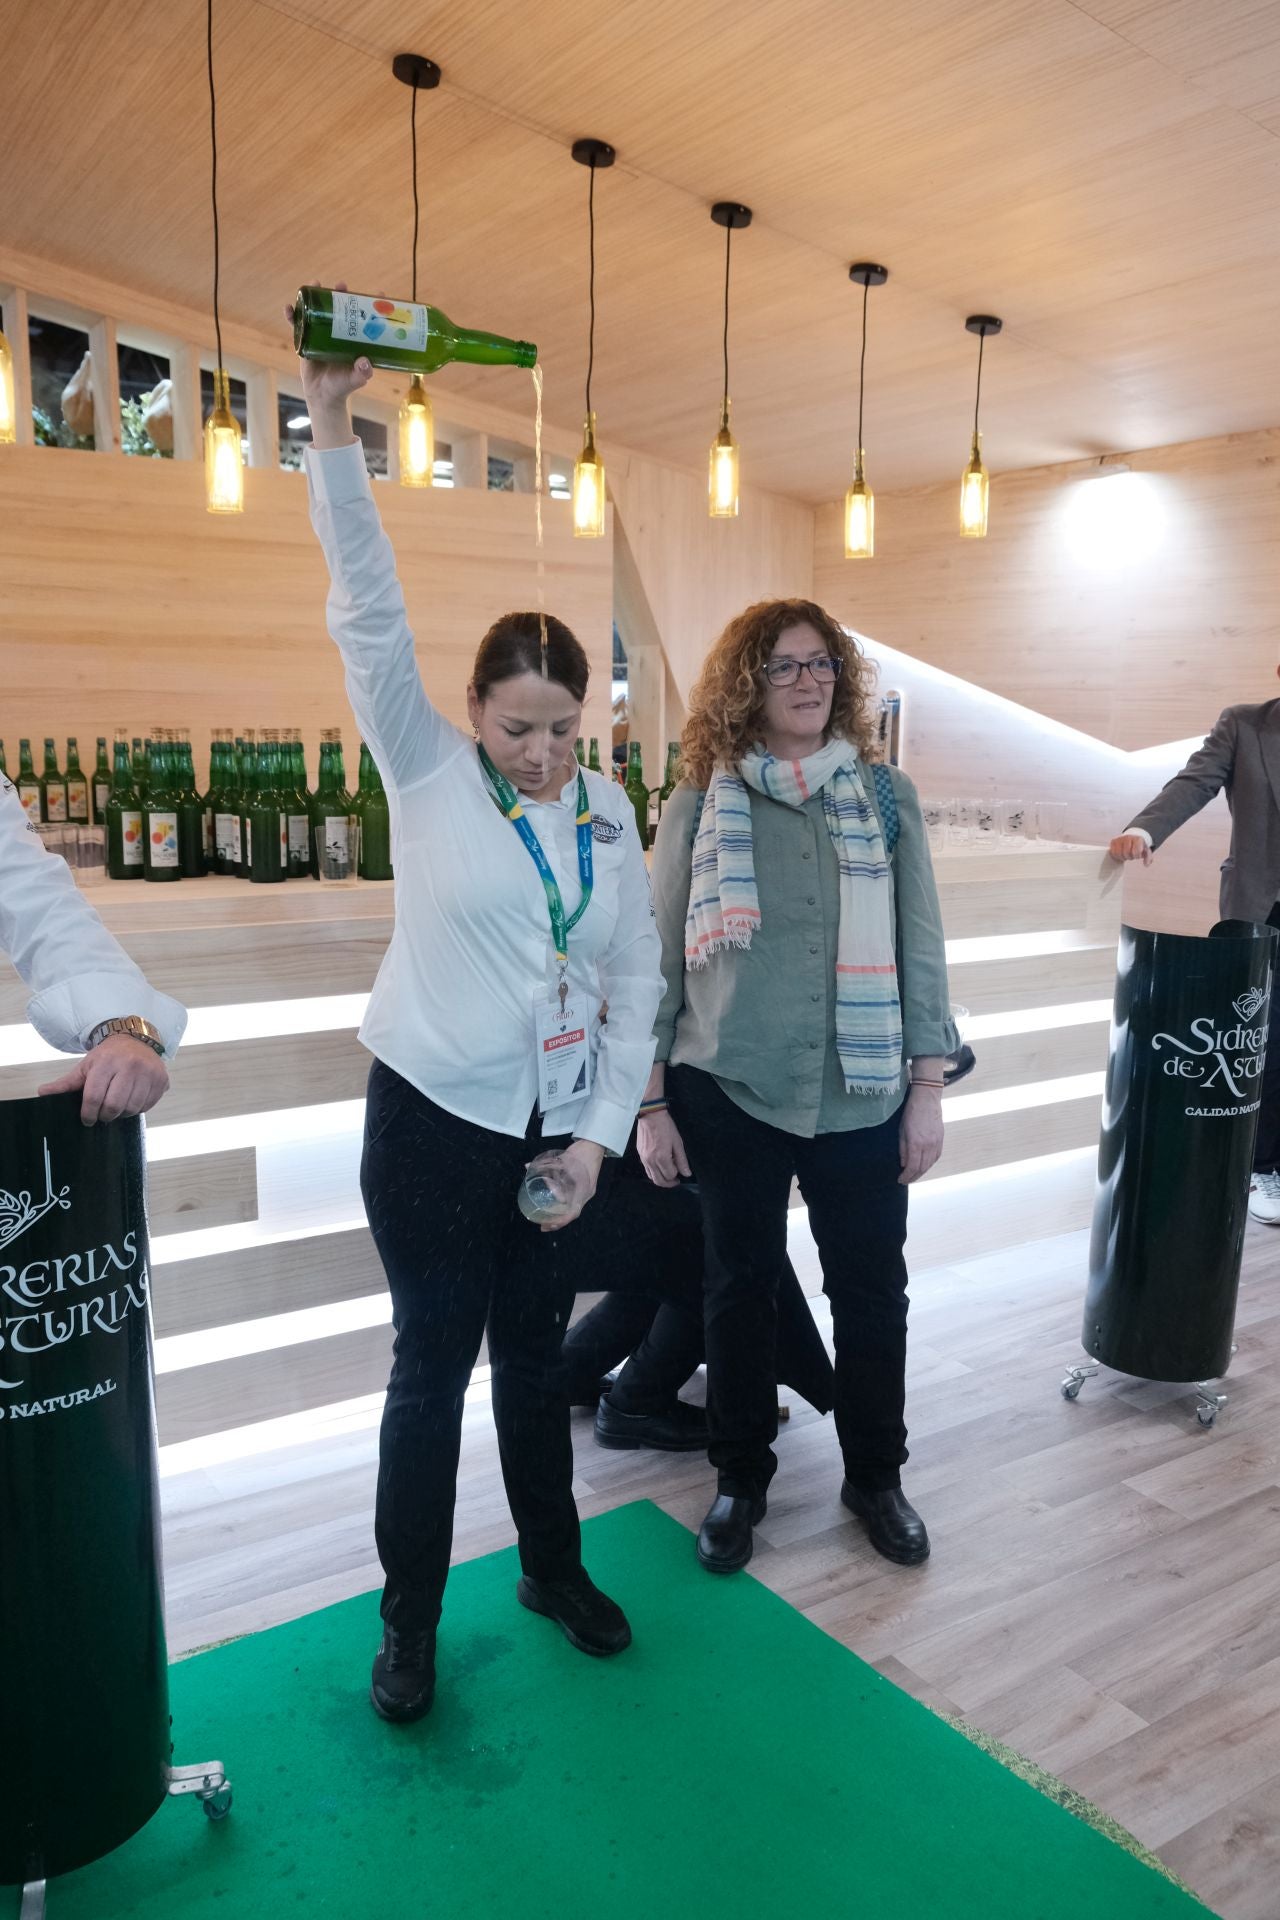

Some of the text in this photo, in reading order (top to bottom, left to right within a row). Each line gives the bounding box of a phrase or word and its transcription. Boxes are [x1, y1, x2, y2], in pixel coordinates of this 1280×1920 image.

[548, 1032, 582, 1048] EXPOSITOR
[1185, 1106, 1239, 1117] CALIDAD
[10, 1378, 117, 1420] NATURAL
